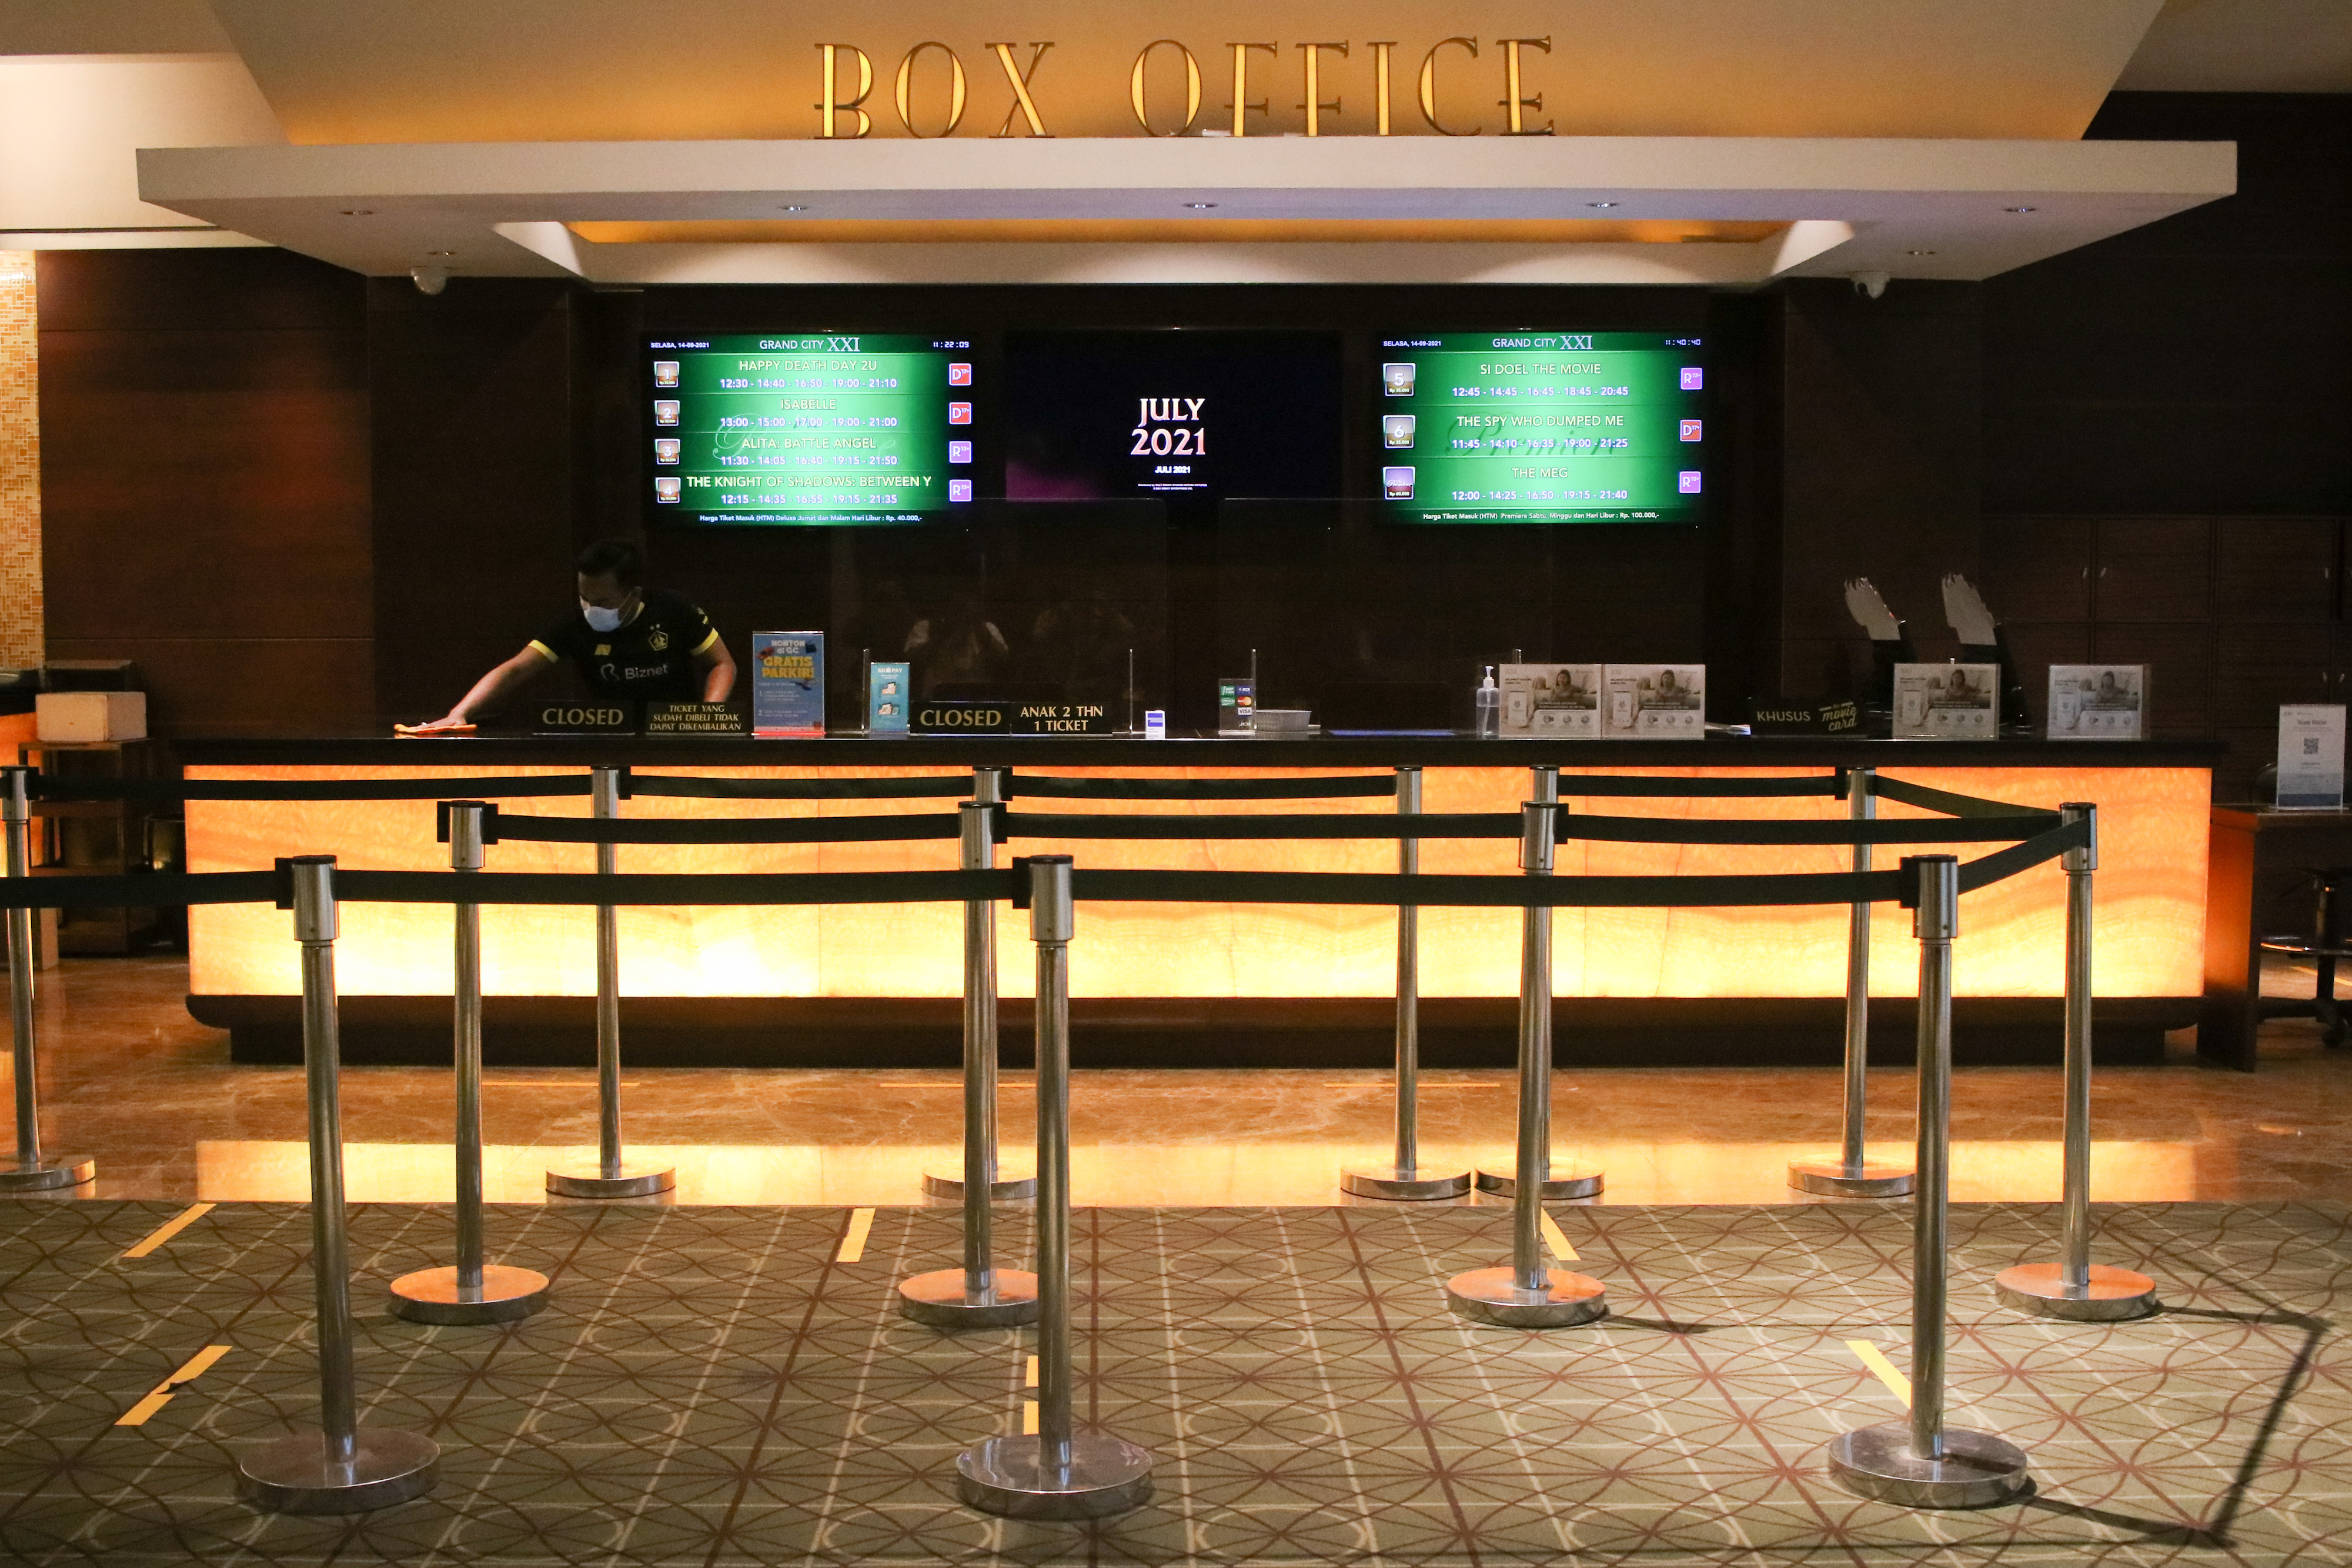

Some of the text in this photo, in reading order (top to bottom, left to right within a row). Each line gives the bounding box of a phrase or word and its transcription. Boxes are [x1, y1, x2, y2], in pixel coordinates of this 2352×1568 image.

[814, 35, 1555, 139] BOX OFFICE
[760, 337, 860, 352] GRAND CITY XXI
[1492, 335, 1593, 350] GRAND CITY XXI
[740, 360, 877, 371] HAPPY DEATH DAY 2U
[1480, 364, 1602, 375] SI DOEL THE MOVIE
[664, 369, 670, 380] 1
[1394, 373, 1405, 386] 5
[720, 379, 898, 388] 12:30 14:40 16:50 19:00 21:10
[1452, 387, 1629, 397] 12:45 14:45 16:45 18:45 20:45
[781, 399, 837, 410] ISABELLE
[663, 408, 672, 419] 2
[1138, 398, 1205, 428] JULY
[720, 417, 749, 427] 13:00
[758, 417, 786, 427] 15:00
[795, 417, 823, 427] 17:00
[833, 417, 860, 427] 19:00
[869, 417, 898, 427] 21:00
[1457, 416, 1624, 427] THE SPY WHO DUMPED ME
[1394, 425, 1405, 439] 6
[741, 438, 877, 449] ALITA: BATTLE ANGEL
[1130, 427, 1206, 456] 2021
[1452, 439, 1628, 449] 11:45 14:10 16:35 19:00 21:25
[664, 446, 672, 457] 3
[721, 456, 898, 466] 11:30 14:05 16:40 19:15 21:50
[1155, 466, 1191, 474] JULI 2021
[1512, 468, 1568, 479] THE MEG
[687, 476, 932, 487] THE KNIGHT OF SHADOWS: BETWEEN Y
[664, 486, 673, 496] 4
[1452, 490, 1628, 500] 12:00 14:25 16:50 19:15 21:40
[721, 494, 898, 504] 12:15 14:35 16:55 19:15 21:35
[1423, 513, 1441, 521] Harga
[763, 656, 813, 667] GRATIS
[624, 664, 669, 680] Biznet
[761, 667, 814, 678] PARKIR!
[542, 708, 624, 725] CLOSED
[1020, 706, 1103, 717] ANAK 2 THN
[1756, 711, 1811, 722] KHUSUS
[1822, 706, 1857, 722] movie
[653, 714, 739, 722] SUDAH DIBELI TIDAK
[920, 710, 1001, 726] CLOSED
[1828, 716, 1857, 731] card
[1034, 720, 1089, 731] 1 TICKET
